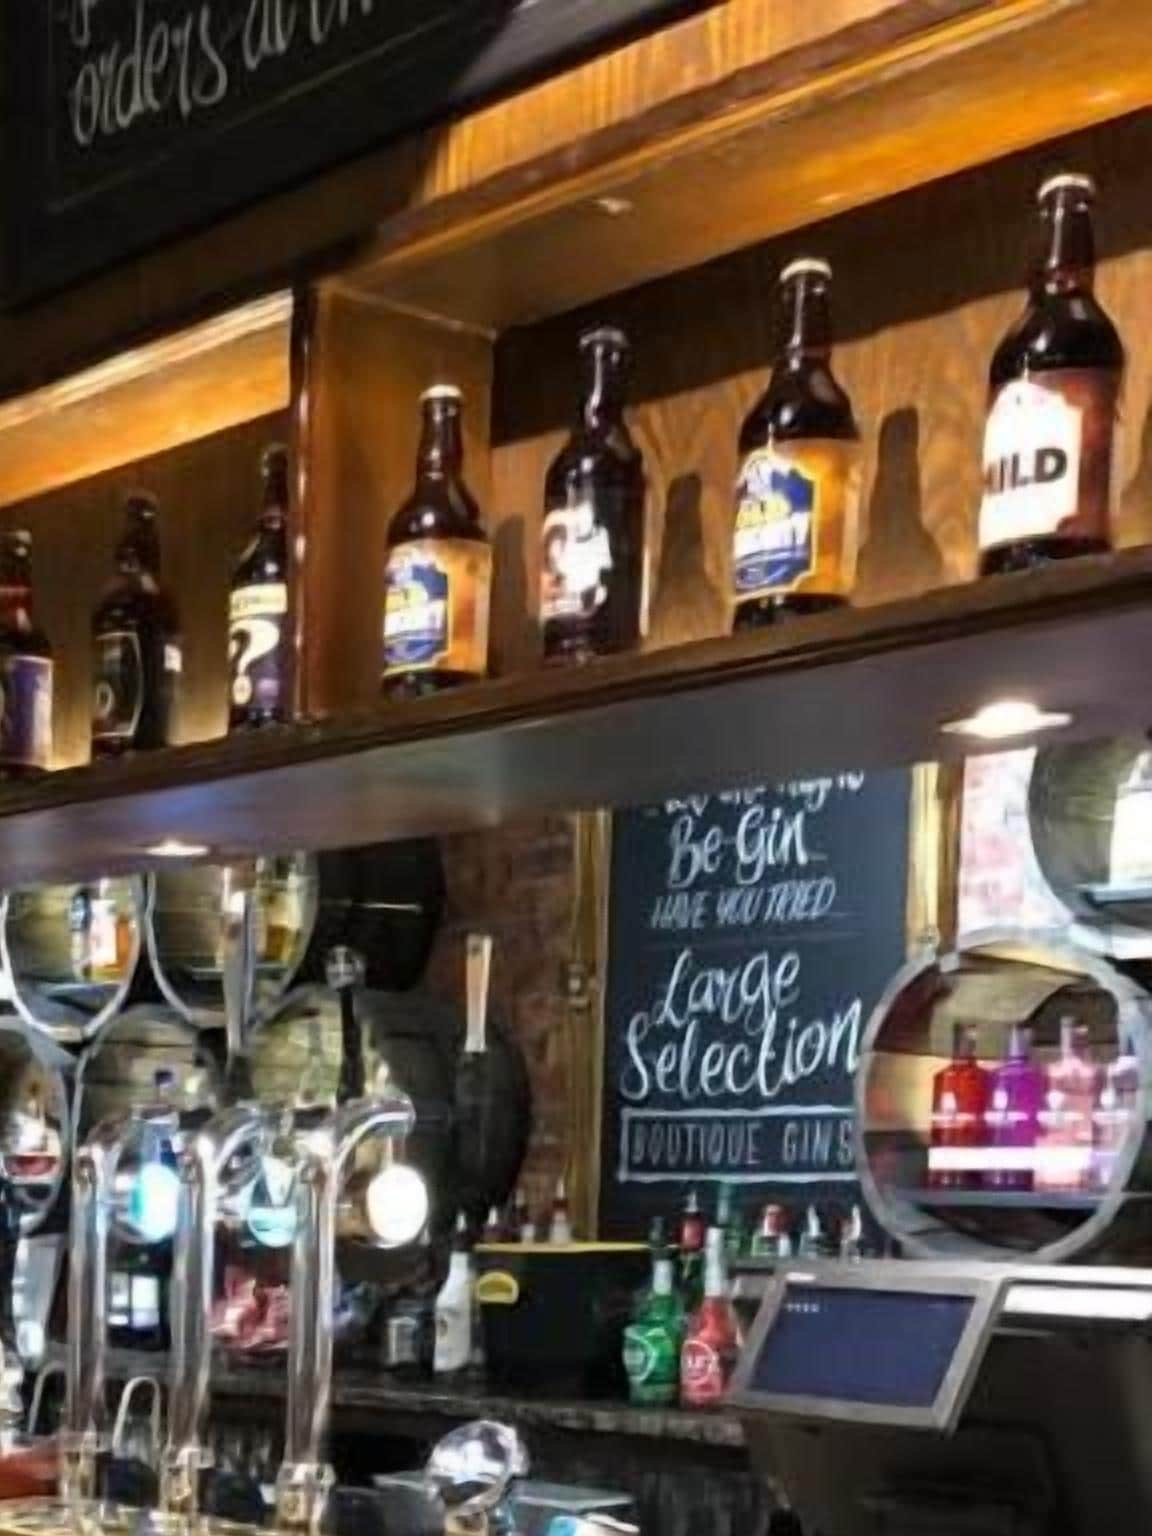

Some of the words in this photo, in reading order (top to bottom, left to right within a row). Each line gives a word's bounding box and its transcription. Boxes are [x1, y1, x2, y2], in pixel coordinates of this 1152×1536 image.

[70, 0, 229, 145] orders
[715, 886, 765, 925] YOU
[652, 948, 800, 1036] Large
[619, 997, 862, 1100] Selection
[631, 1121, 762, 1167] BOUTIQUE
[782, 1118, 855, 1167] GINS
